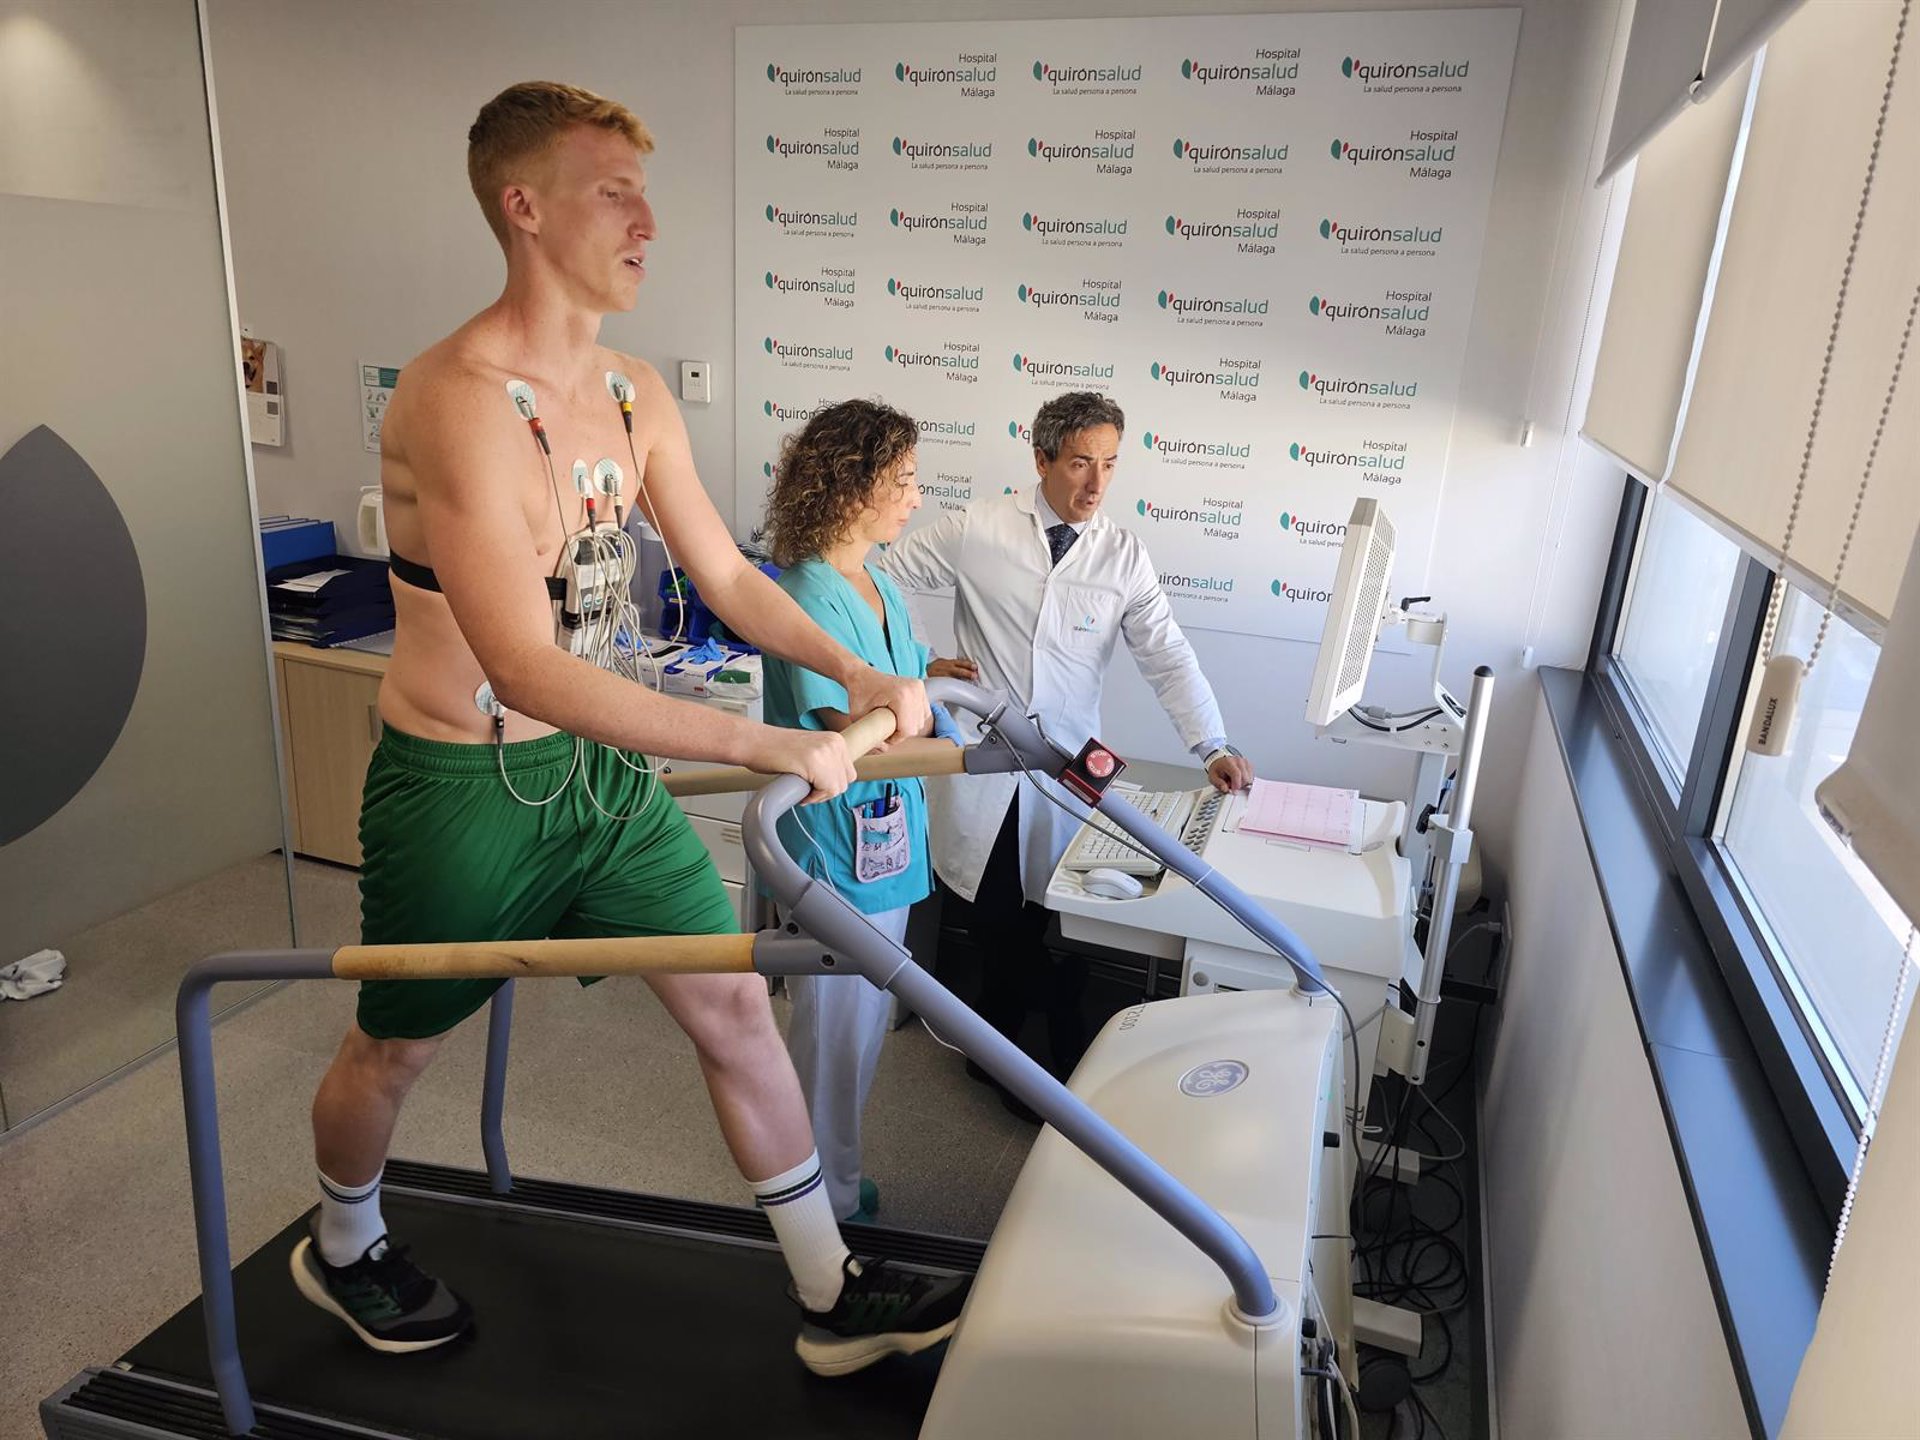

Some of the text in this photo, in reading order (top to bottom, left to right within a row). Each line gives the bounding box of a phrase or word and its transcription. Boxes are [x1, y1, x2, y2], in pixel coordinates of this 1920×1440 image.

[959, 53, 997, 64] Hospital
[1256, 48, 1300, 61] Hospital
[780, 68, 861, 87] quirónsalud
[910, 67, 996, 87] quirónsalud
[1048, 65, 1141, 86] quirónsalud
[1197, 63, 1298, 84] quirónsalud
[1359, 60, 1469, 82] quirónsalud
[961, 88, 995, 99] Málaga
[1256, 85, 1295, 98] Málaga
[824, 128, 859, 138] Hospital
[1095, 129, 1136, 141] Hospital
[1410, 130, 1458, 142] Hospital
[780, 141, 858, 158] quirónsalud
[906, 143, 992, 159] quirónsalud
[1042, 144, 1134, 162] quirónsalud
[1189, 145, 1288, 164] quirónsalud
[1348, 145, 1456, 165] quirónsalud
[828, 160, 858, 171] Málaga
[1097, 164, 1132, 176] Málaga
[1410, 167, 1451, 180] Málaga
[951, 202, 988, 213] Hospital
[1237, 208, 1280, 221] Hospital
[779, 211, 857, 227] quirónsalud
[904, 216, 987, 232] quirónsalud
[1037, 220, 1127, 236] quirónsalud
[1181, 223, 1278, 240] quirónsalud
[1336, 226, 1442, 245] quirónsalud
[954, 235, 986, 246] Málaga
[1238, 243, 1275, 255] Málaga
[822, 267, 855, 278] Hospital
[779, 279, 854, 294] quirónsalud
[1083, 279, 1122, 290] Hospital
[901, 285, 983, 301] quirónsalud
[1032, 292, 1120, 308] quirónsalud
[1386, 291, 1432, 302] Hospital
[824, 298, 854, 308] Málaga
[1173, 298, 1268, 315] quirónsalud
[1084, 311, 1118, 323] Málaga
[1326, 304, 1429, 322] quirónsalud
[1386, 325, 1426, 338] Málaga
[777, 344, 852, 360] quirónsalud
[944, 342, 979, 353] Hospital
[898, 352, 978, 368] quirónsalud
[1220, 358, 1261, 370] Hospital
[947, 372, 977, 383] Málaga
[1027, 361, 1114, 378] quirónsalud
[1166, 369, 1259, 386] quirónsalud
[1315, 379, 1417, 396] quirónsalud
[1220, 390, 1256, 403] Málaga
[776, 406, 816, 421] quirón
[916, 420, 975, 436] rónsalud
[1158, 440, 1250, 458] quirónsalud
[1363, 440, 1407, 452] Hospital
[1305, 452, 1406, 469] quirónsalud
[937, 473, 972, 484] Hospital
[1363, 472, 1401, 485] Málaga
[918, 484, 972, 500] ónsalud
[1203, 497, 1243, 509] Hospital
[1151, 506, 1242, 525] quirónsalud
[1204, 528, 1238, 540] Málaga
[1295, 520, 1347, 536] quirón
[1158, 572, 1232, 591] irónsalud
[1758, 698, 1778, 745] BANDALUX
